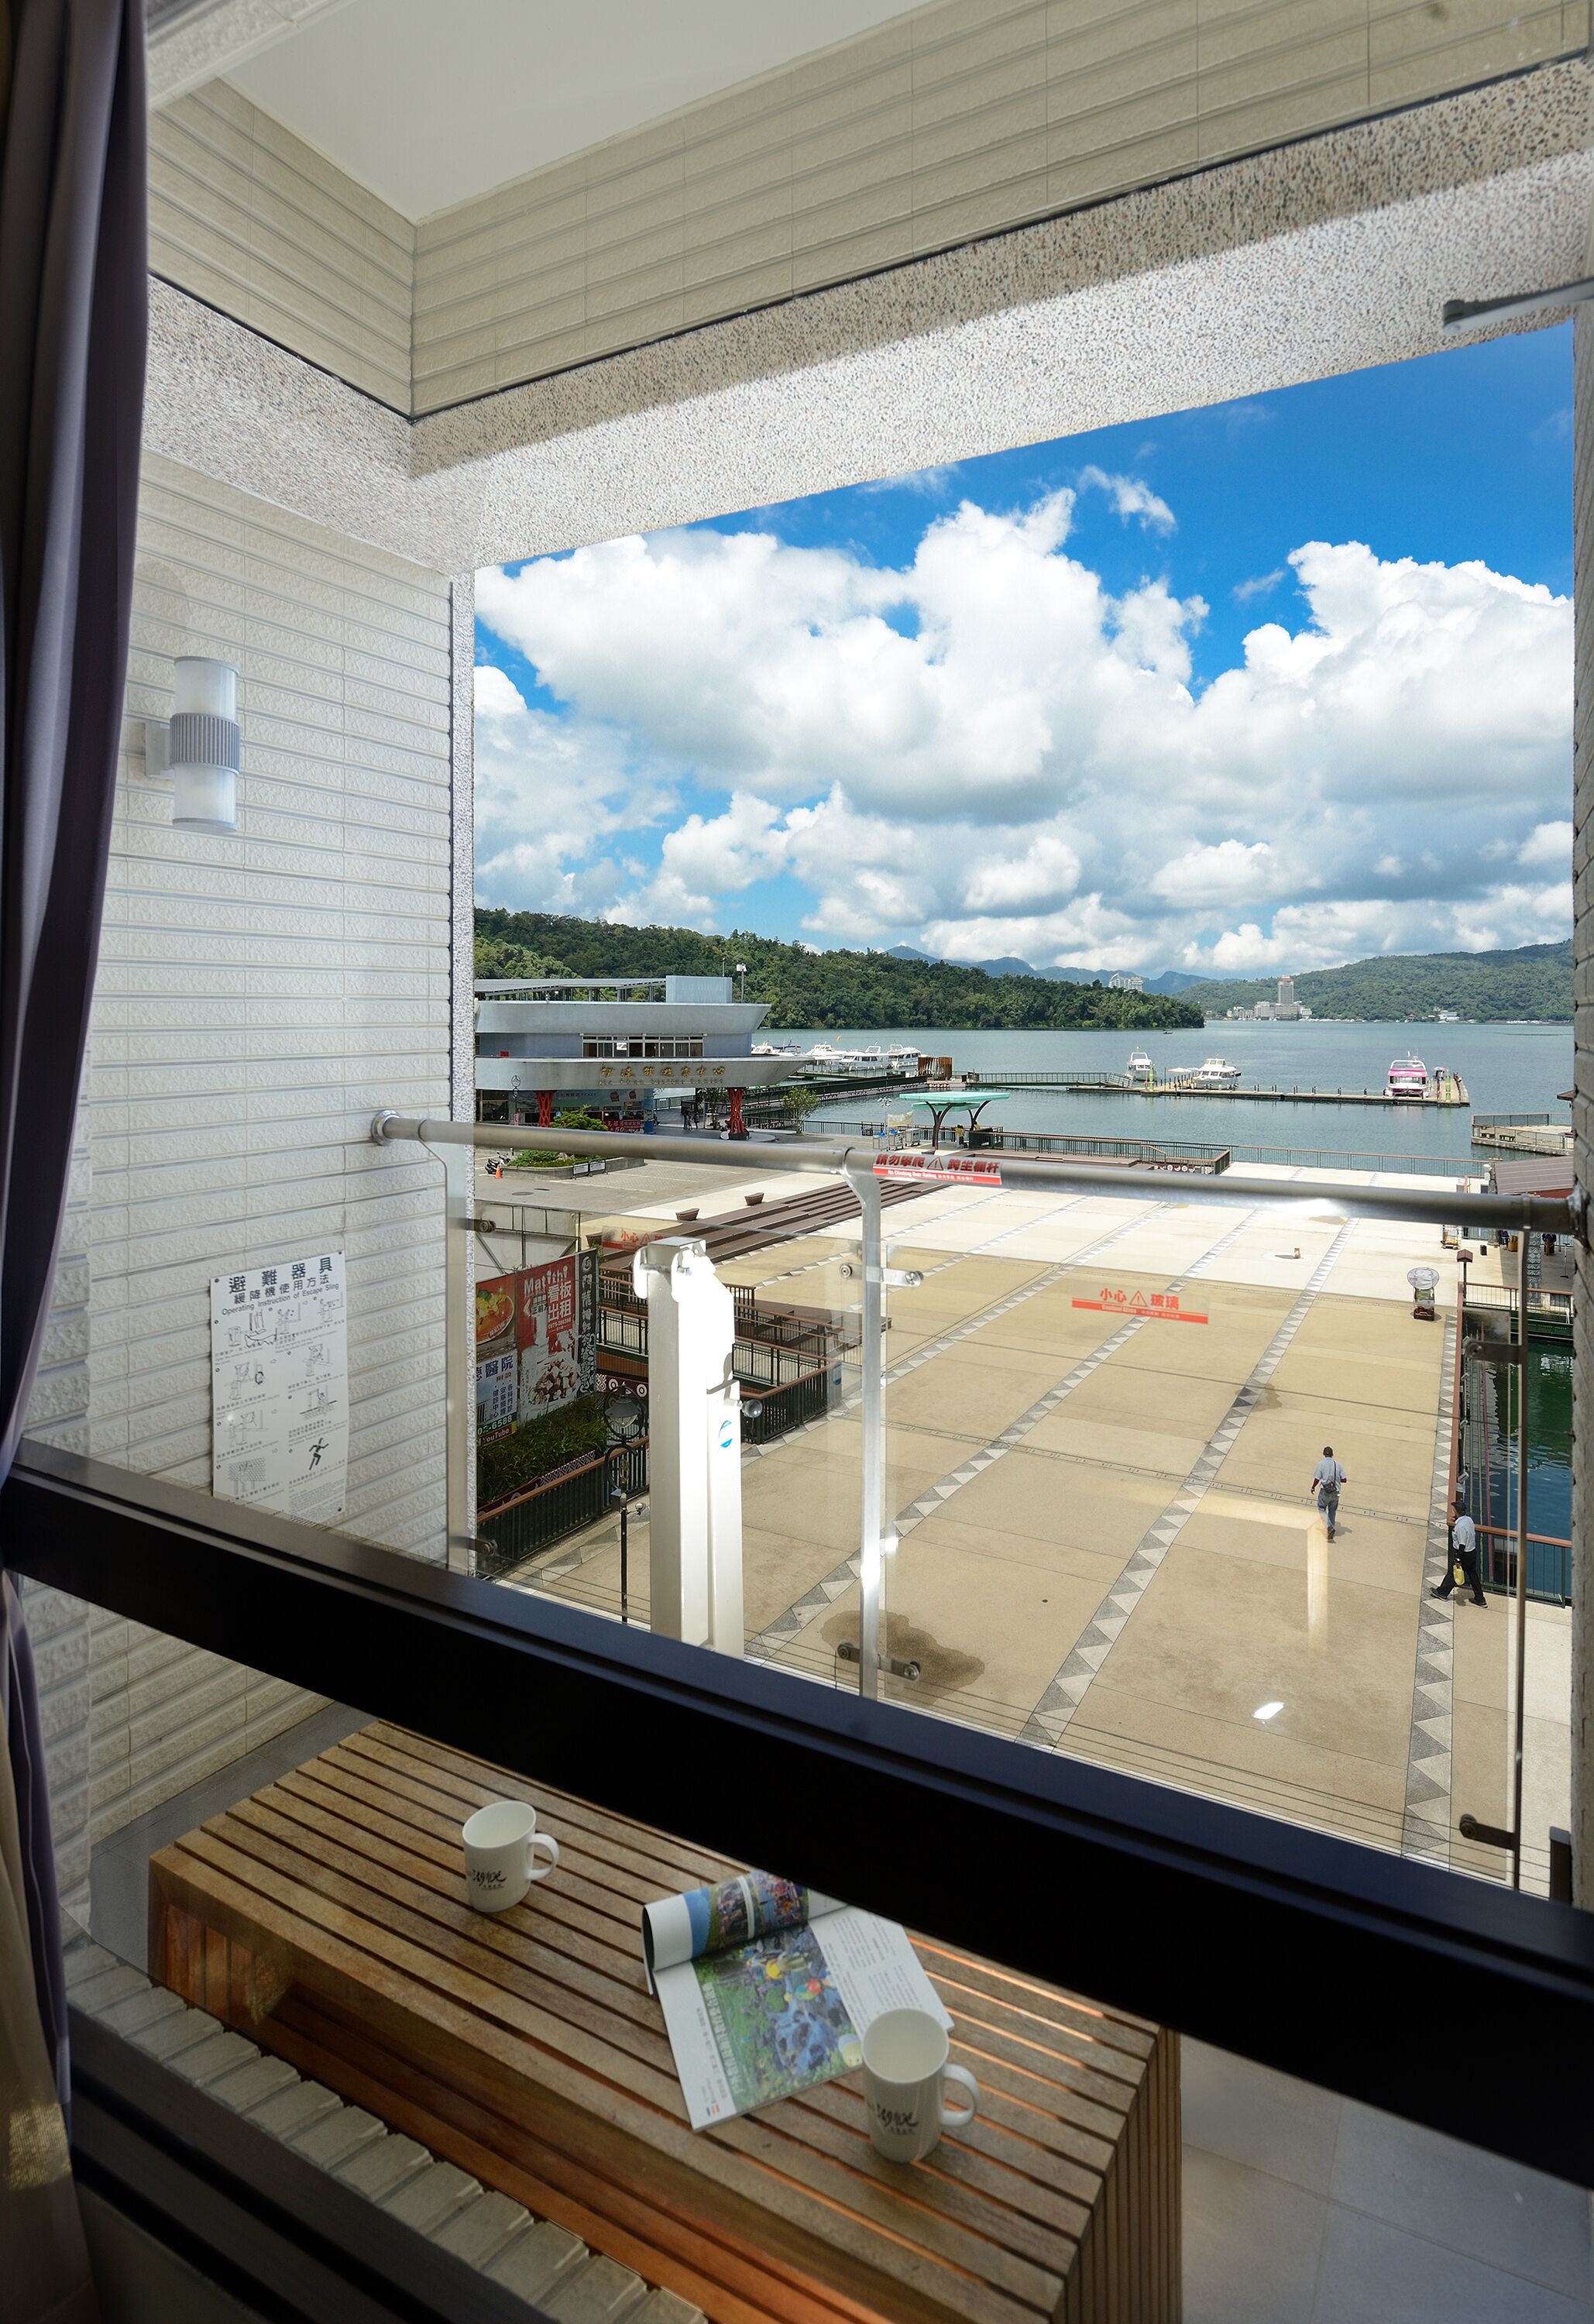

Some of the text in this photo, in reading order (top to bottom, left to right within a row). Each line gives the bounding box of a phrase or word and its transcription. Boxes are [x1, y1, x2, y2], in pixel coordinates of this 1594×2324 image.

[876, 1153, 926, 1168] 請勿攀爬
[620, 1229, 640, 1243] 小心
[228, 1257, 332, 1294] 避難器具
[222, 1303, 255, 1316] Operating
[257, 1294, 291, 1308] Instruction
[302, 1287, 323, 1298] Escape
[325, 1283, 339, 1292] Sling
[233, 1274, 330, 1305] 緩降機使用方法
[548, 1280, 572, 1304] 看板
[1100, 1288, 1128, 1302] 小心
[1150, 1293, 1180, 1310] 玻璃
[548, 1298, 572, 1322] 出租
[482, 1428, 510, 1444] YouTube
